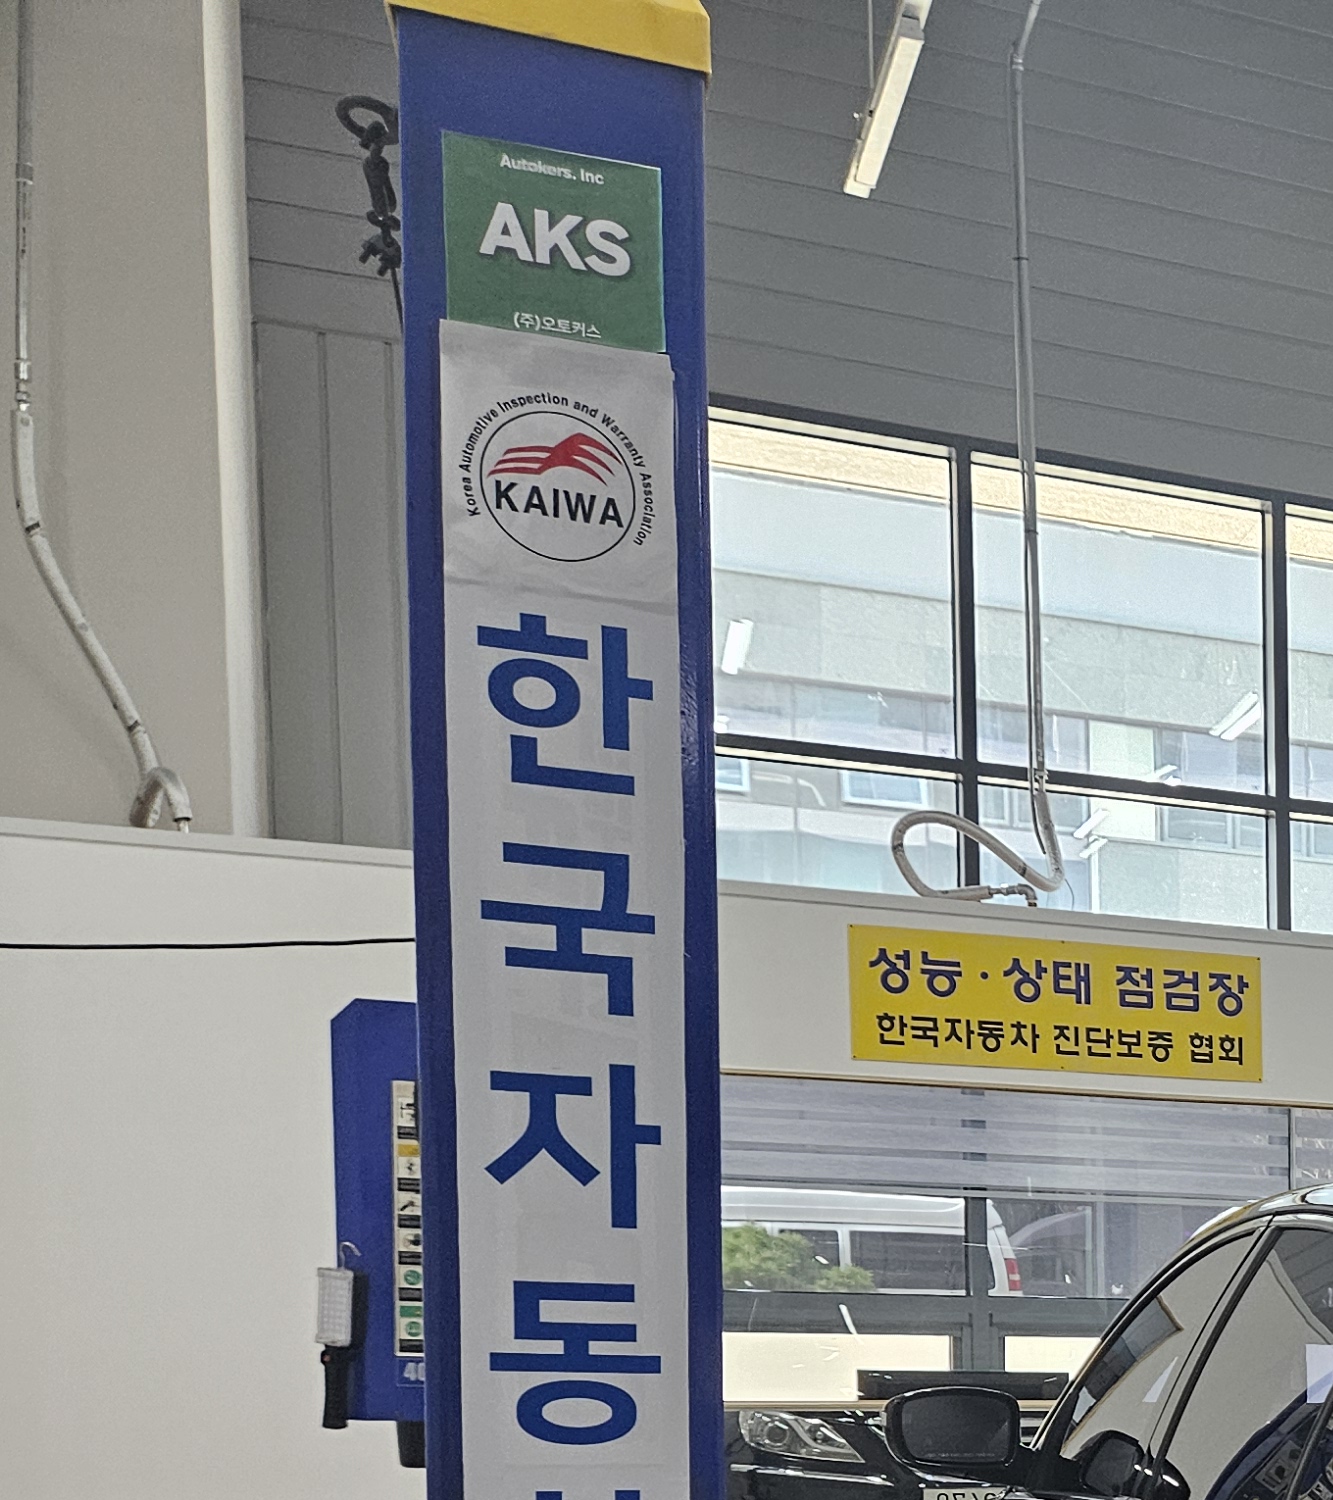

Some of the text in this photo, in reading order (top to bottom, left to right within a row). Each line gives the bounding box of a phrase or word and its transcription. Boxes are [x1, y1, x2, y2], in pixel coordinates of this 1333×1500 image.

[580, 168, 604, 185] Inc
[478, 201, 631, 277] AKS
[513, 311, 602, 338] (주)오토커스
[459, 392, 656, 546] Korea Automotive Inspection and Warranty Association
[494, 479, 625, 529] KAIWA
[1115, 964, 1249, 1017] 점검장
[875, 1011, 1244, 1066] 한국자동차 진단보증 협회
